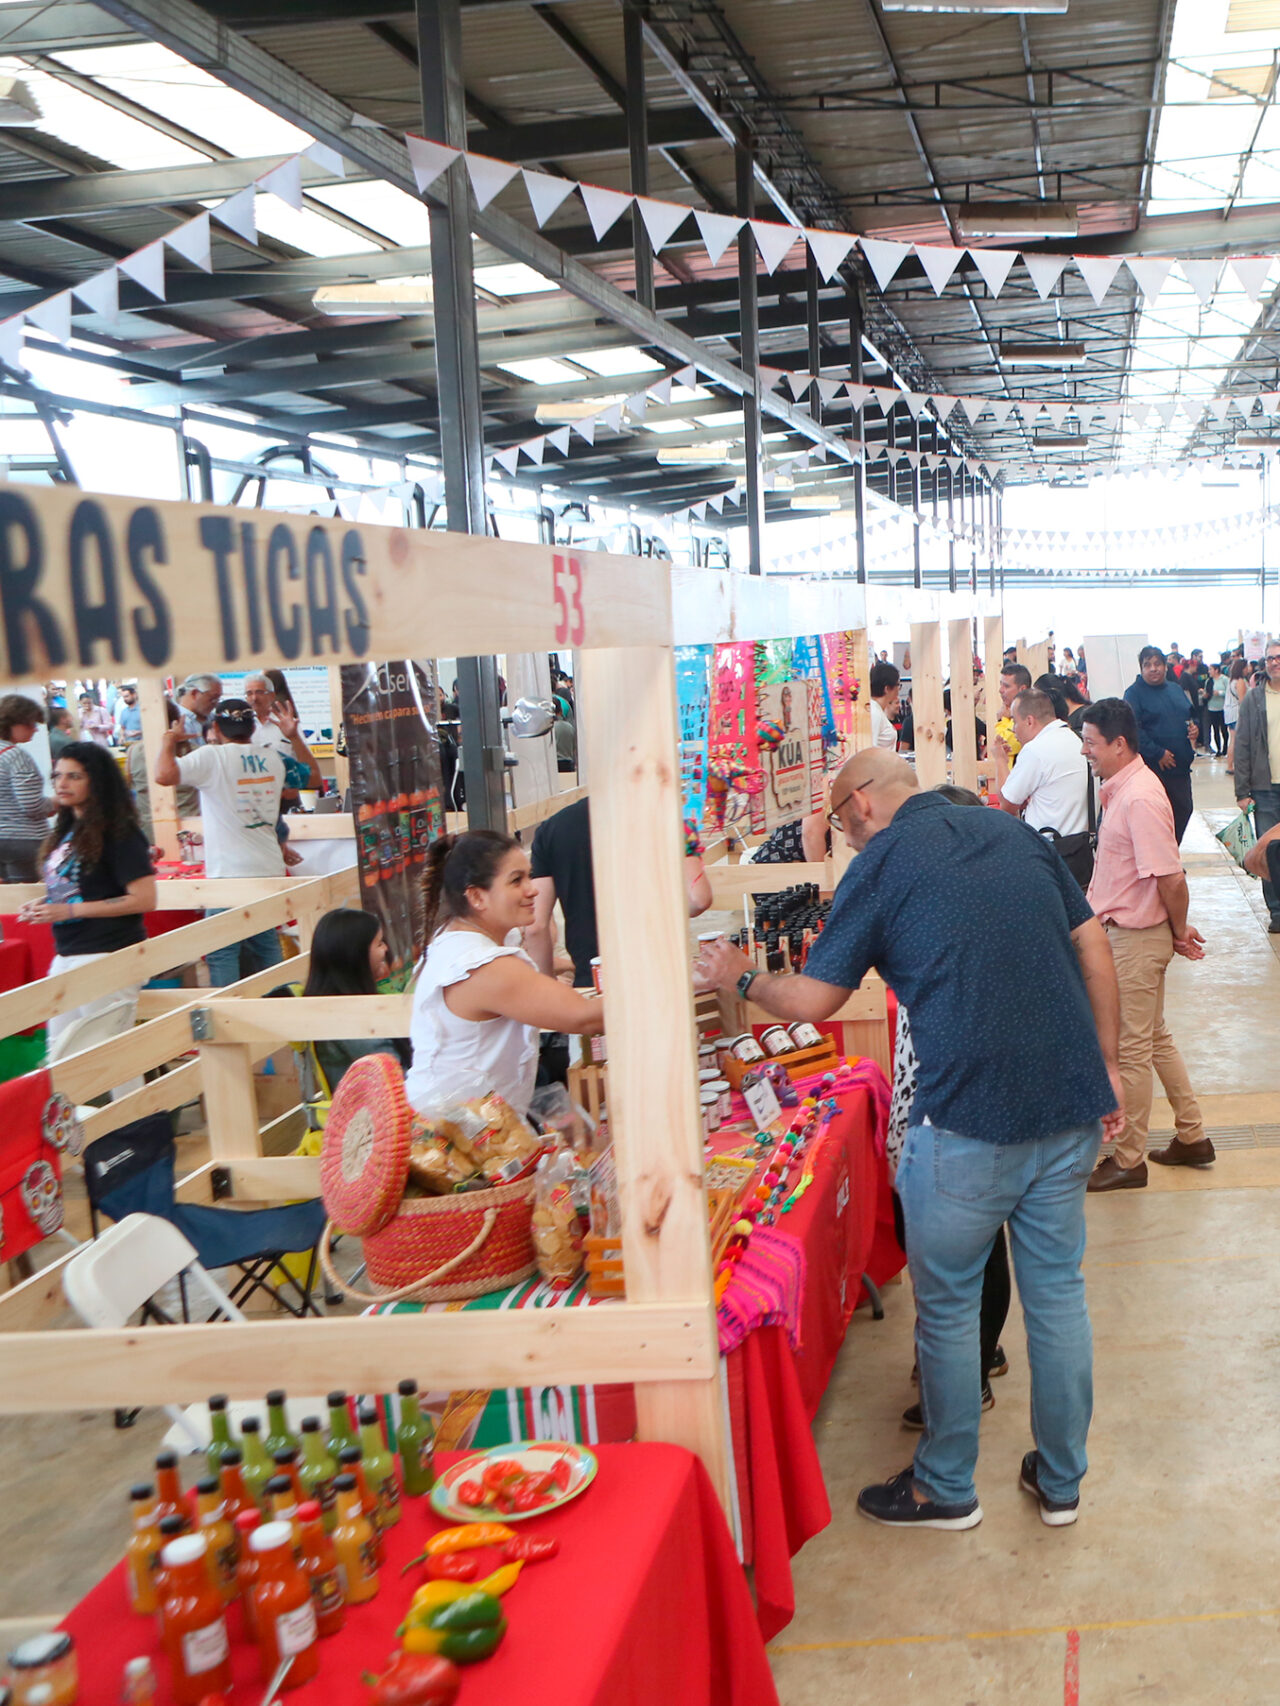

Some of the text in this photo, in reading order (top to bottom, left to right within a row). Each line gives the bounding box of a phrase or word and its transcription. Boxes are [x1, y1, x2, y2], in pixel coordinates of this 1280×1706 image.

[0, 488, 371, 677] RAS TICAS
[552, 553, 585, 647] 53
[778, 738, 804, 769] KÚA
